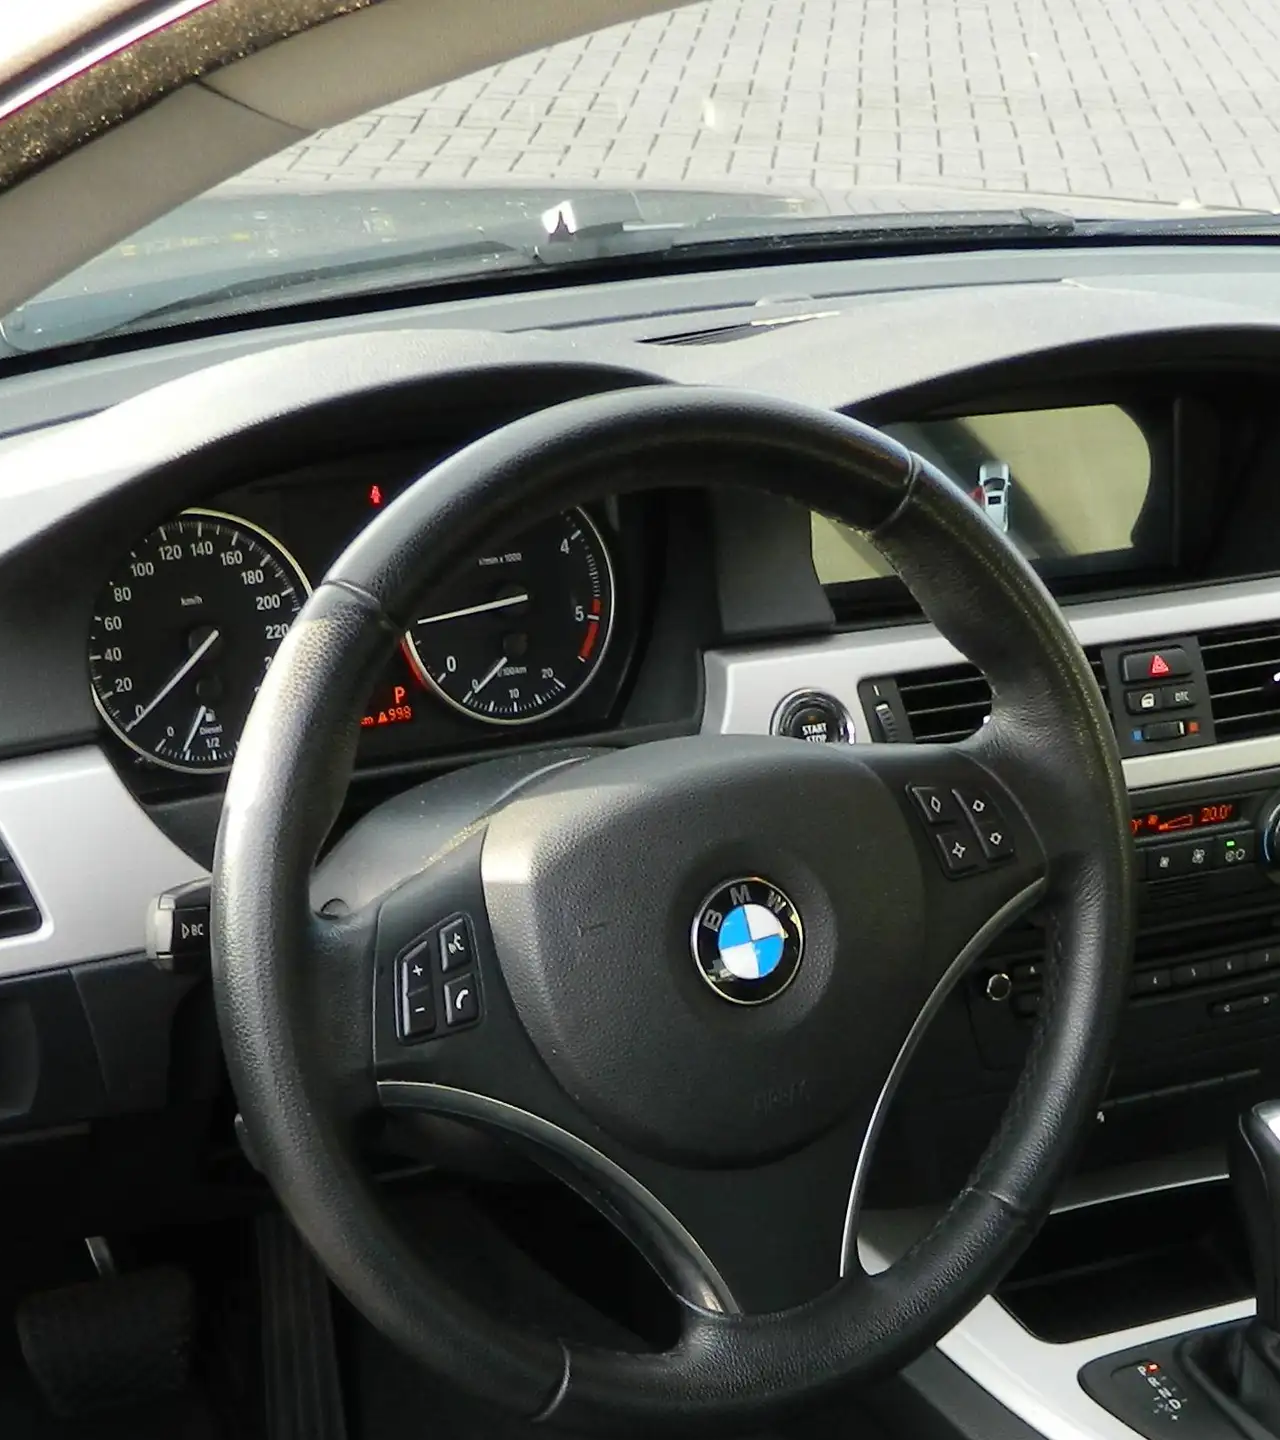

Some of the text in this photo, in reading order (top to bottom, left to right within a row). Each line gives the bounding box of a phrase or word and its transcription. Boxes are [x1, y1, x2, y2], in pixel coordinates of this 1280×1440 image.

[158, 545, 182, 560] 120
[190, 541, 213, 556] 140
[560, 538, 569, 554] 4
[220, 550, 243, 566] 160
[130, 562, 154, 576] 100
[240, 570, 264, 585] 180
[114, 587, 132, 602] 80
[256, 594, 280, 611] 200
[575, 605, 584, 621] 5
[104, 616, 122, 631] 60
[265, 623, 289, 640] 220
[104, 647, 122, 662] 40
[446, 656, 456, 672] 0
[541, 667, 554, 679] 20
[114, 677, 132, 693] 20
[394, 686, 406, 704] P
[508, 688, 520, 699] 10
[166, 726, 175, 737] 0
[802, 722, 827, 736] START
[206, 737, 220, 748] 1/2
[703, 884, 787, 932] BMW
[191, 924, 204, 936] BC
[1168, 1398, 1182, 1410] D
